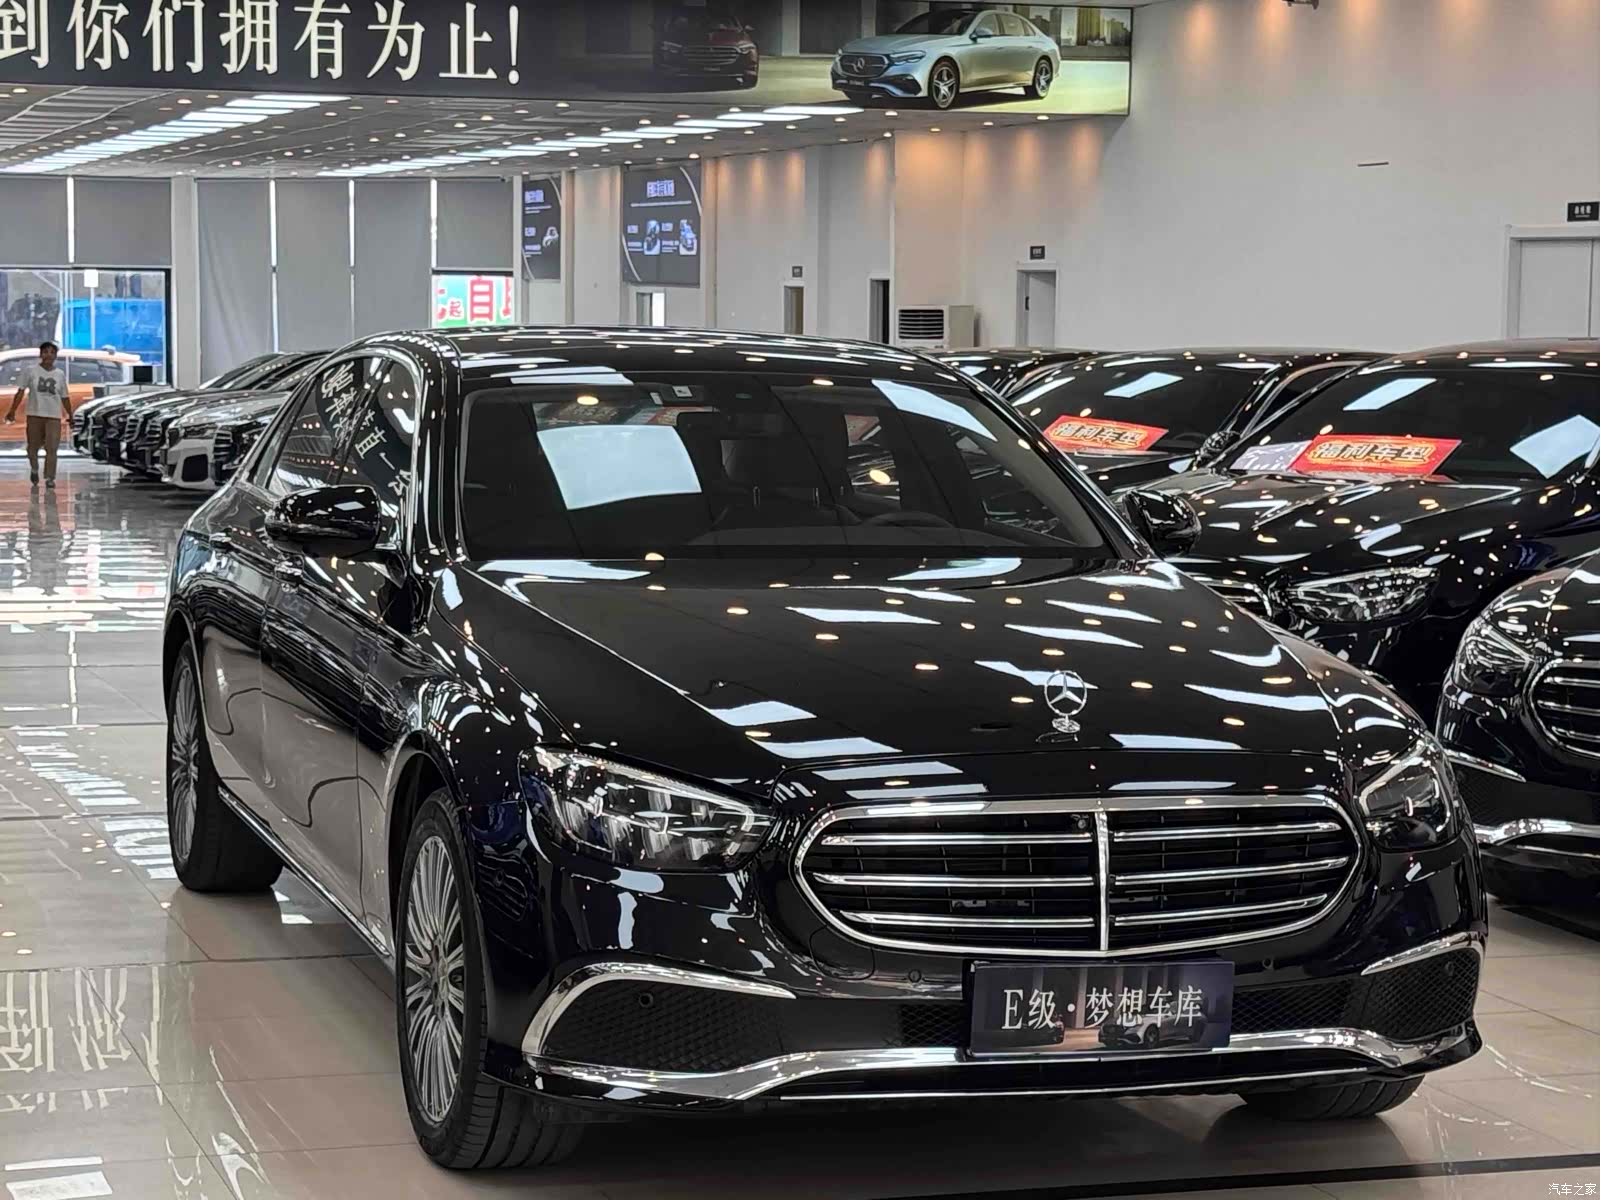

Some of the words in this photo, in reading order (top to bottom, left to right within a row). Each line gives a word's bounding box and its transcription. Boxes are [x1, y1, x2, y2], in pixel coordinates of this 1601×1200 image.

[1054, 423, 1142, 445] 福利车型
[1313, 442, 1430, 464] 福利车型
